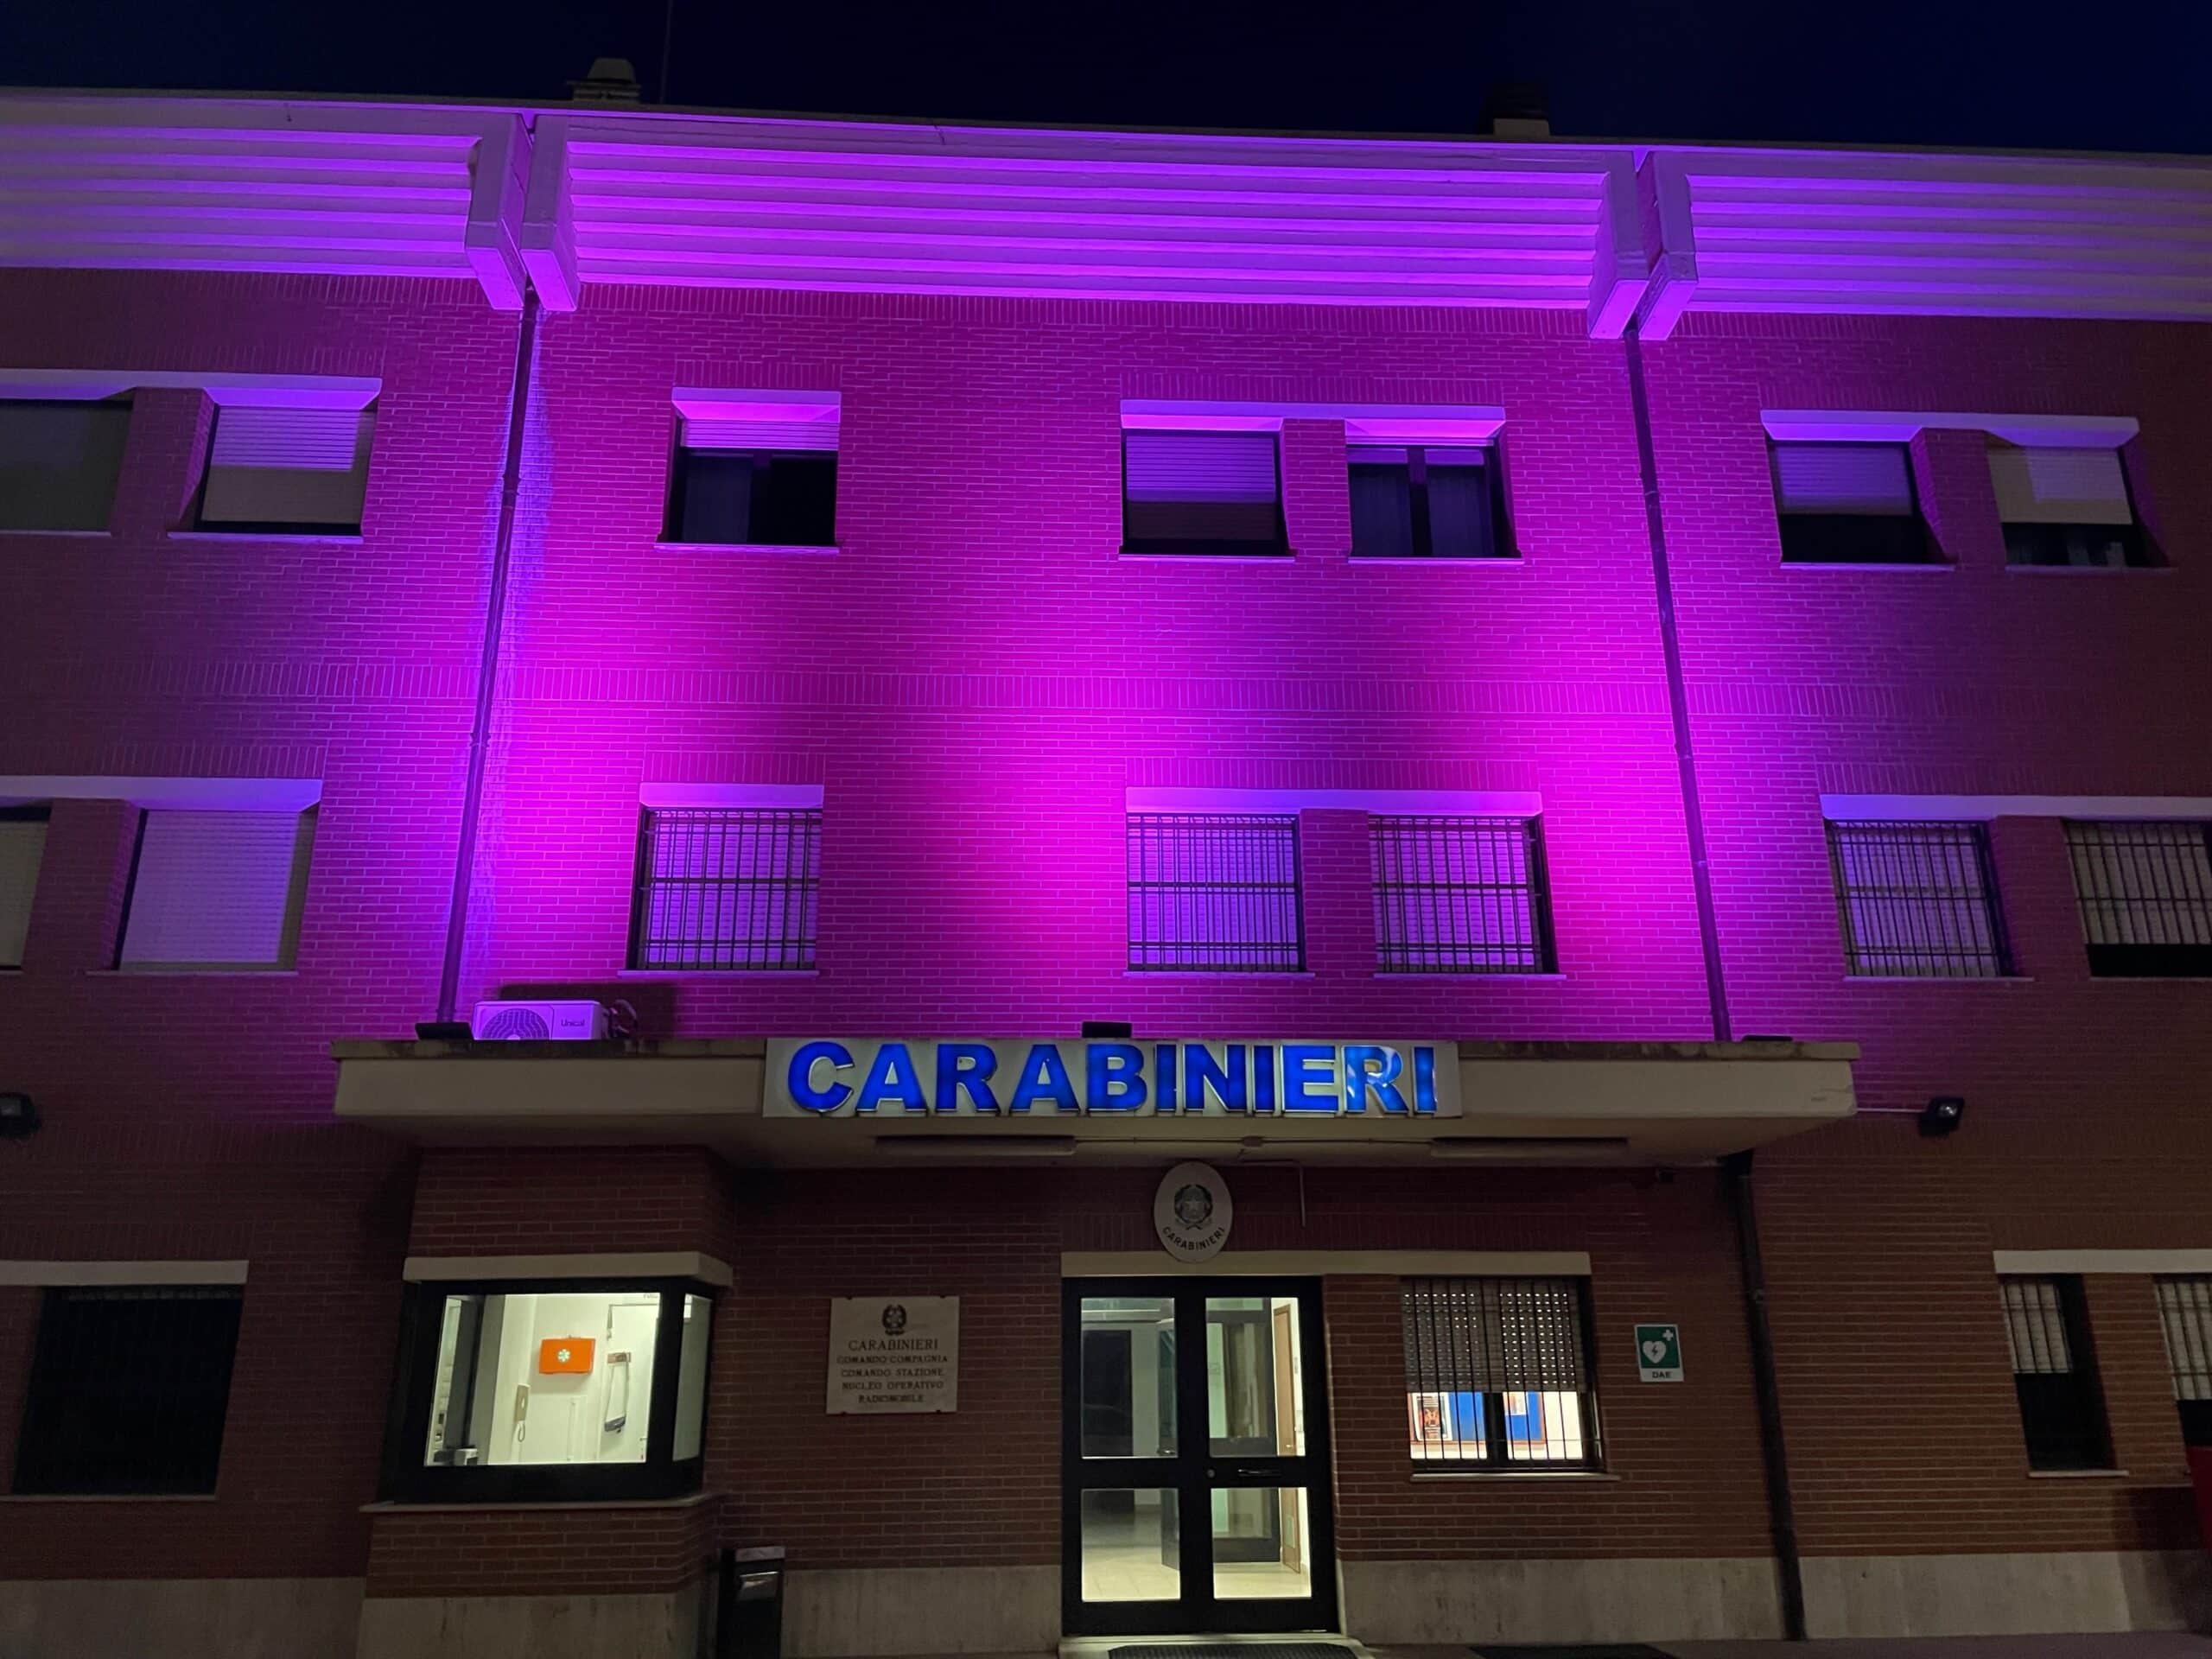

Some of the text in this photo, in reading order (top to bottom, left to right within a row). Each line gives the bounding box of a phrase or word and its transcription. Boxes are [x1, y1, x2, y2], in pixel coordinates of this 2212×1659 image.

[787, 1041, 1438, 1112] CARABINIERI
[1162, 1227, 1225, 1250] CARABINIERI
[848, 1339, 938, 1351] CARABINIERI
[836, 1355, 887, 1363] COMANDO
[842, 1368, 944, 1377] COMANDO STAZIONE
[842, 1382, 944, 1390] NUCLEO OPERATIVO
